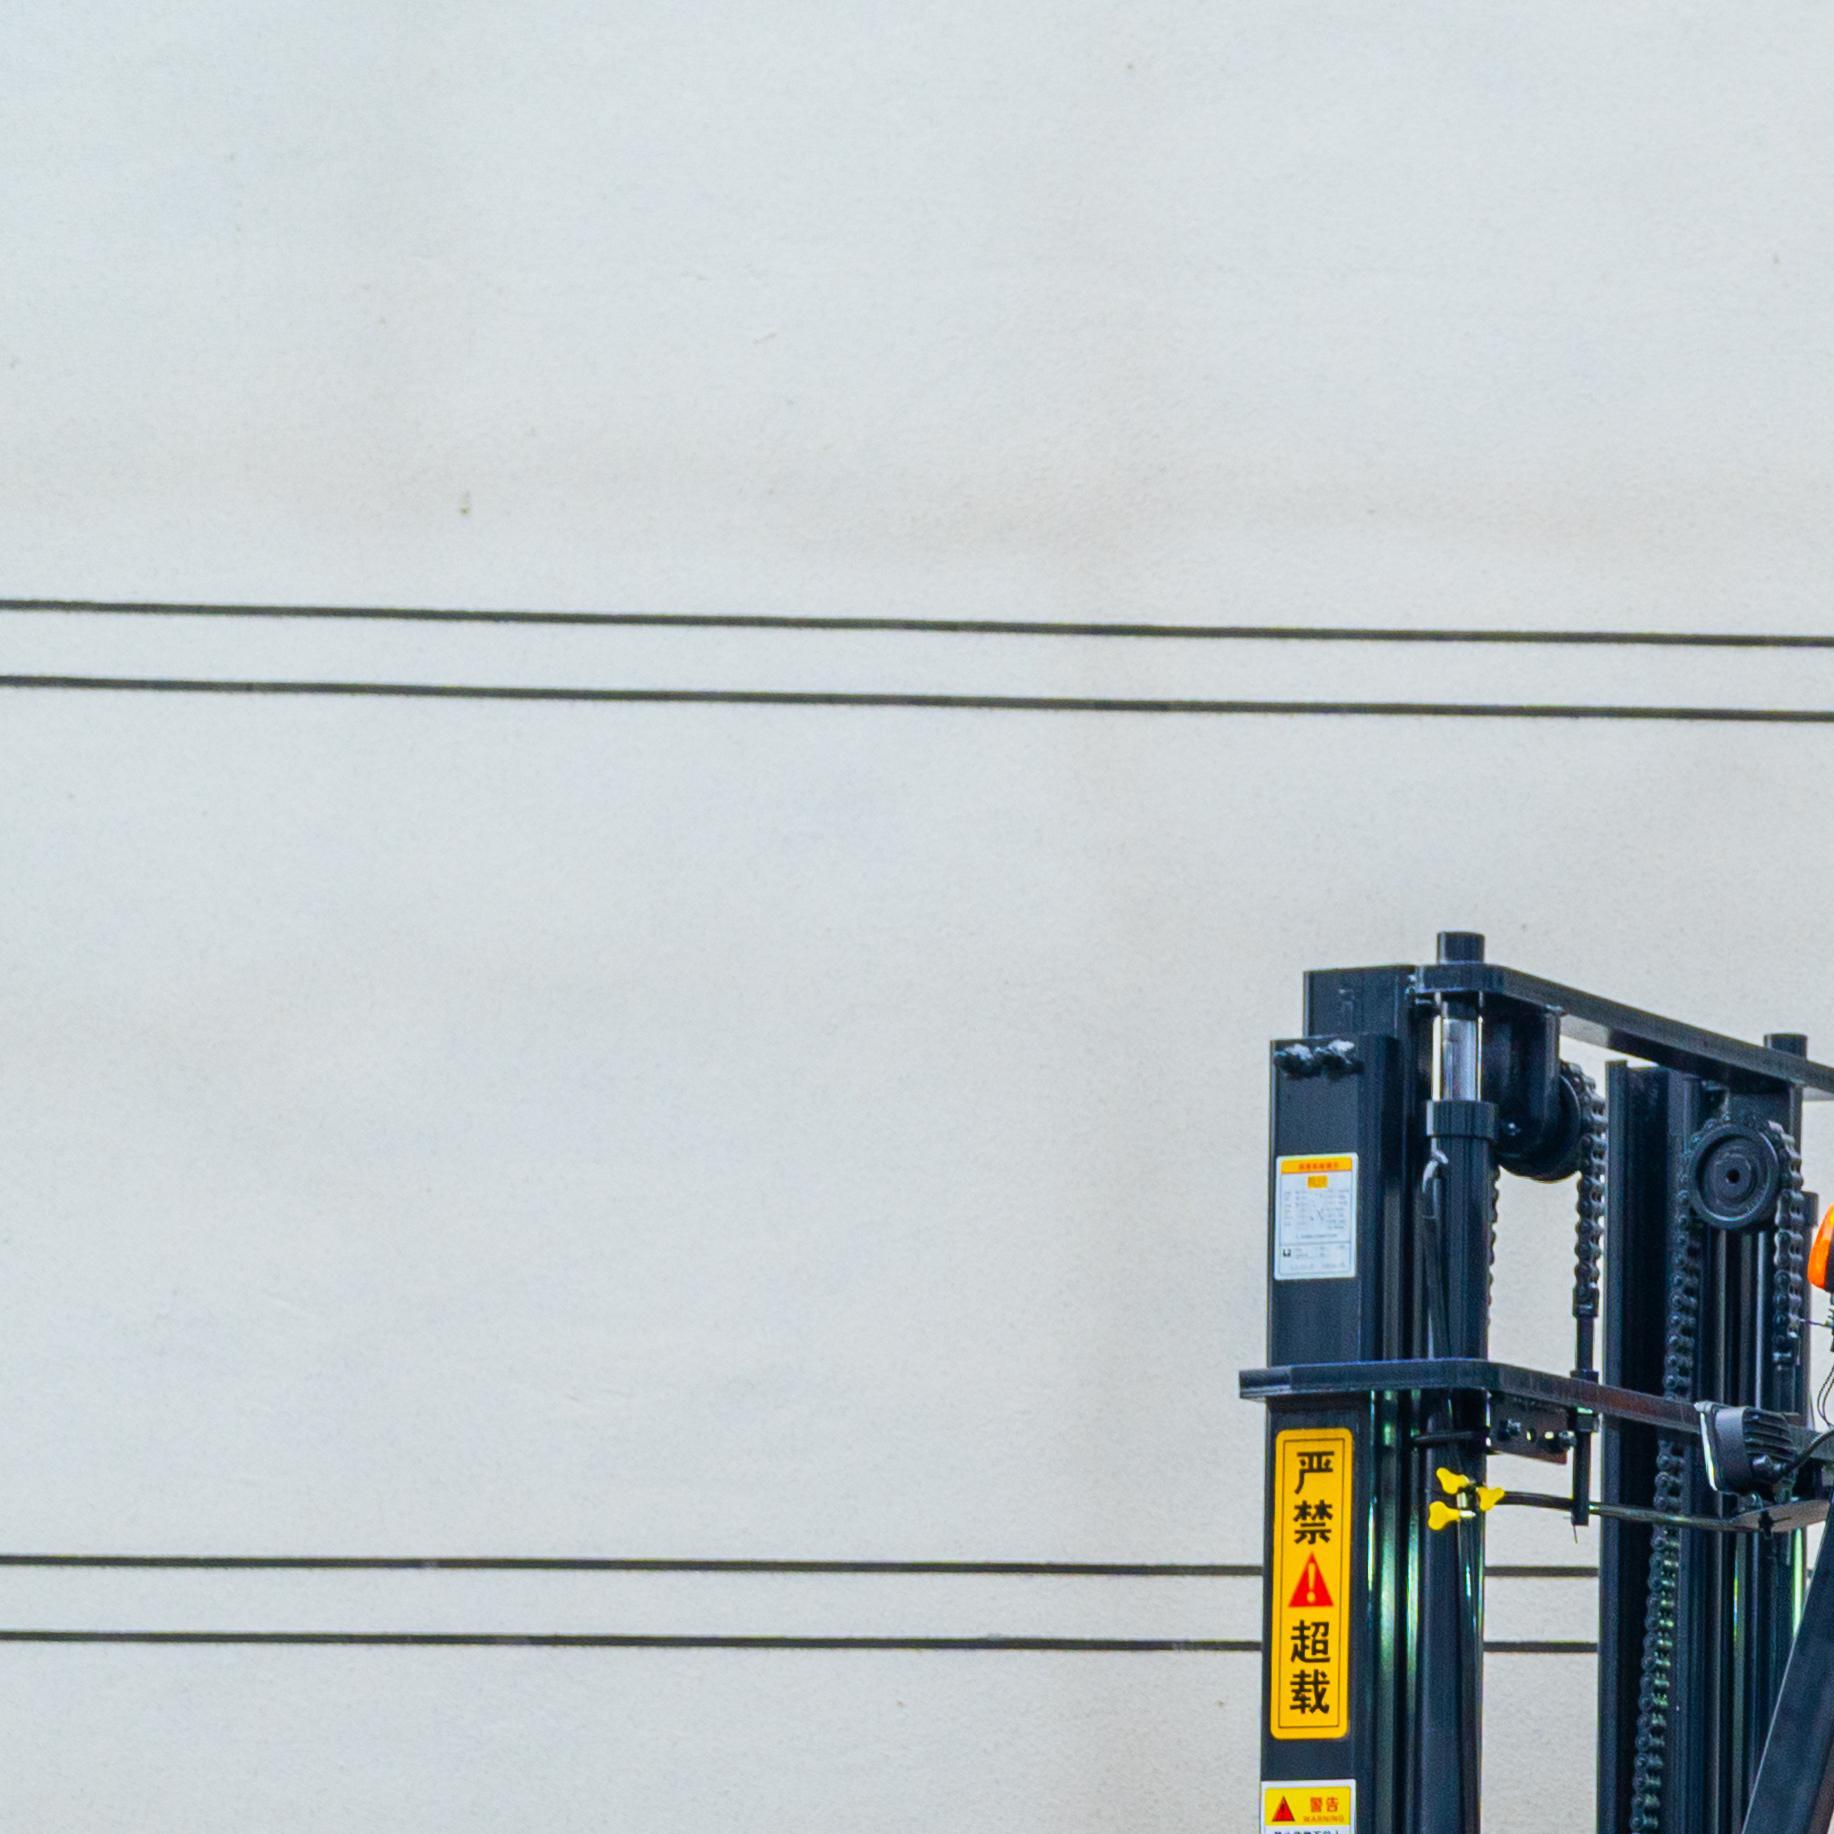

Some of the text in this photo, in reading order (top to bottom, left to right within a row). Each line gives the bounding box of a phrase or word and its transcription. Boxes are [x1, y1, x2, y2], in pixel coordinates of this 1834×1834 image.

[1289, 1451, 1335, 1714] 严禁 超载
[1310, 1796, 1339, 1812] 警告
